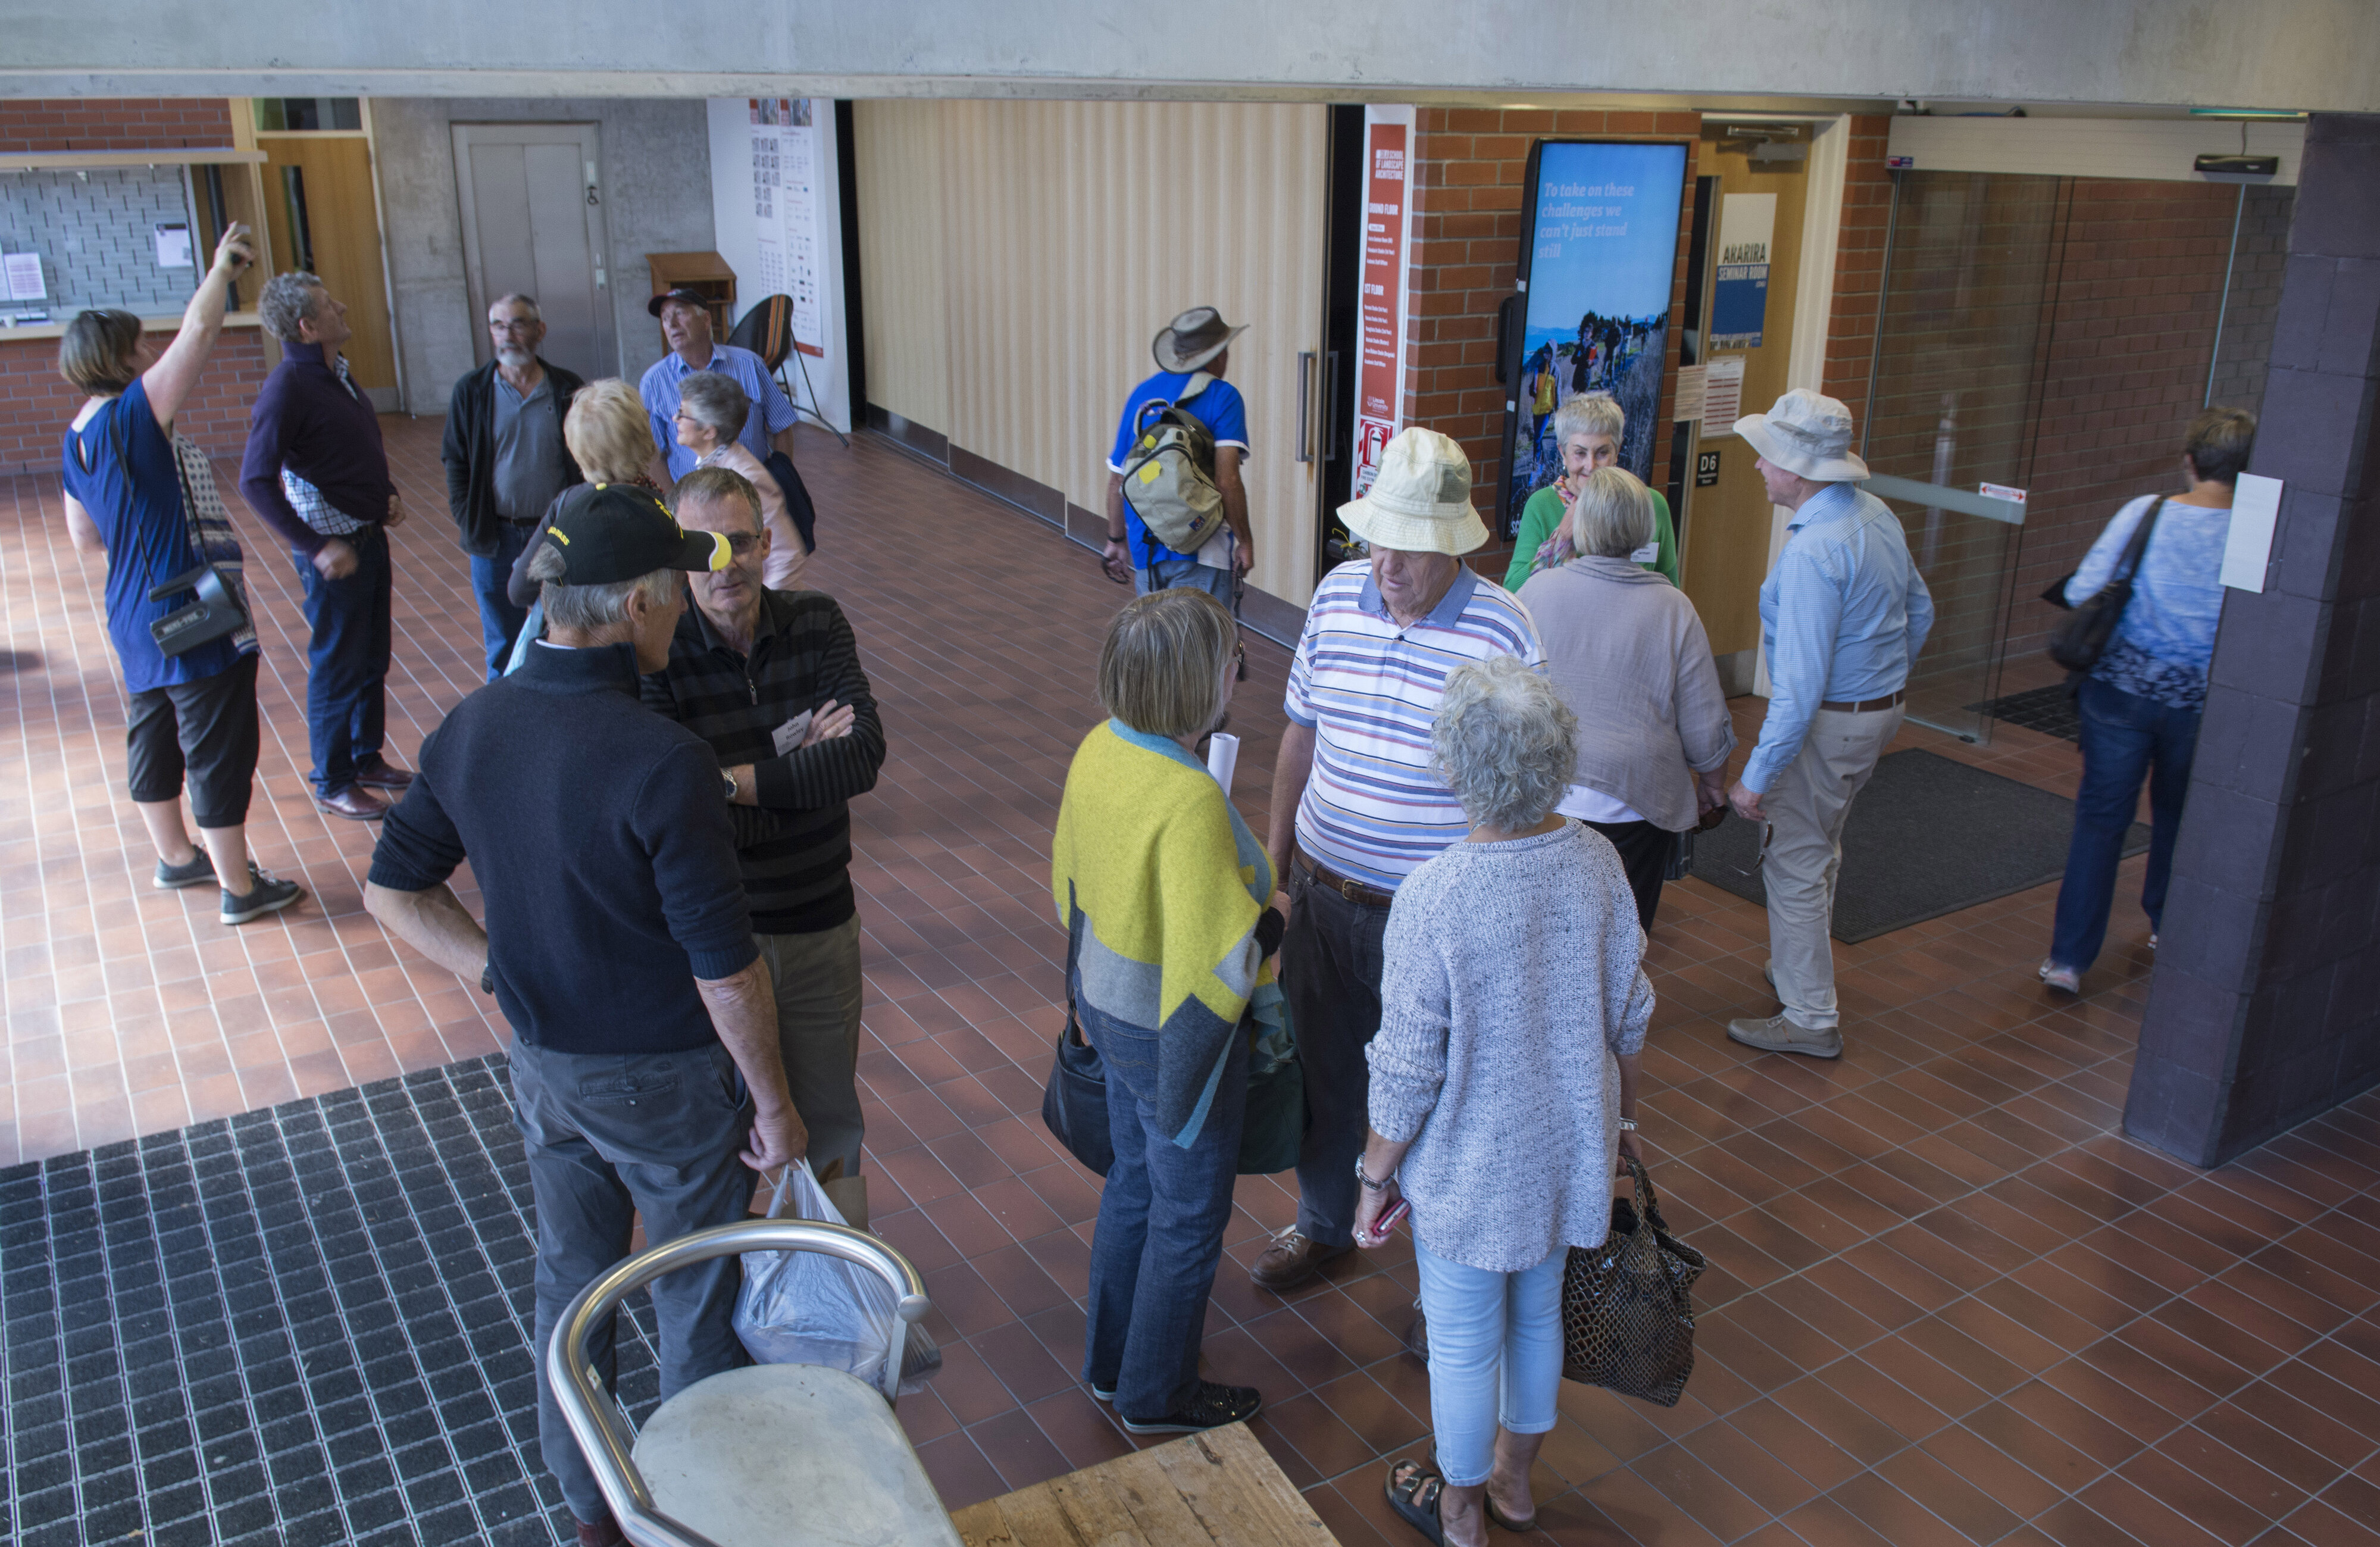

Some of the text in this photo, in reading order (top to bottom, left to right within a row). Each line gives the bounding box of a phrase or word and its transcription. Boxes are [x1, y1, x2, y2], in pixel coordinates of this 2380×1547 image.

[1381, 160, 1403, 170] LANDSCAPE
[1375, 169, 1403, 180] ARCHITECTURE
[1544, 182, 1635, 197] To take on these
[1384, 204, 1399, 215] FLOOR
[1541, 202, 1622, 221] challenges we
[1540, 221, 1628, 241] can't just stand
[1538, 243, 1562, 258] still
[1718, 265, 1768, 281] SEMINAR ROOM
[1371, 284, 1384, 296] FLOOR
[787, 722, 799, 731] John
[786, 727, 804, 740] Rowley
